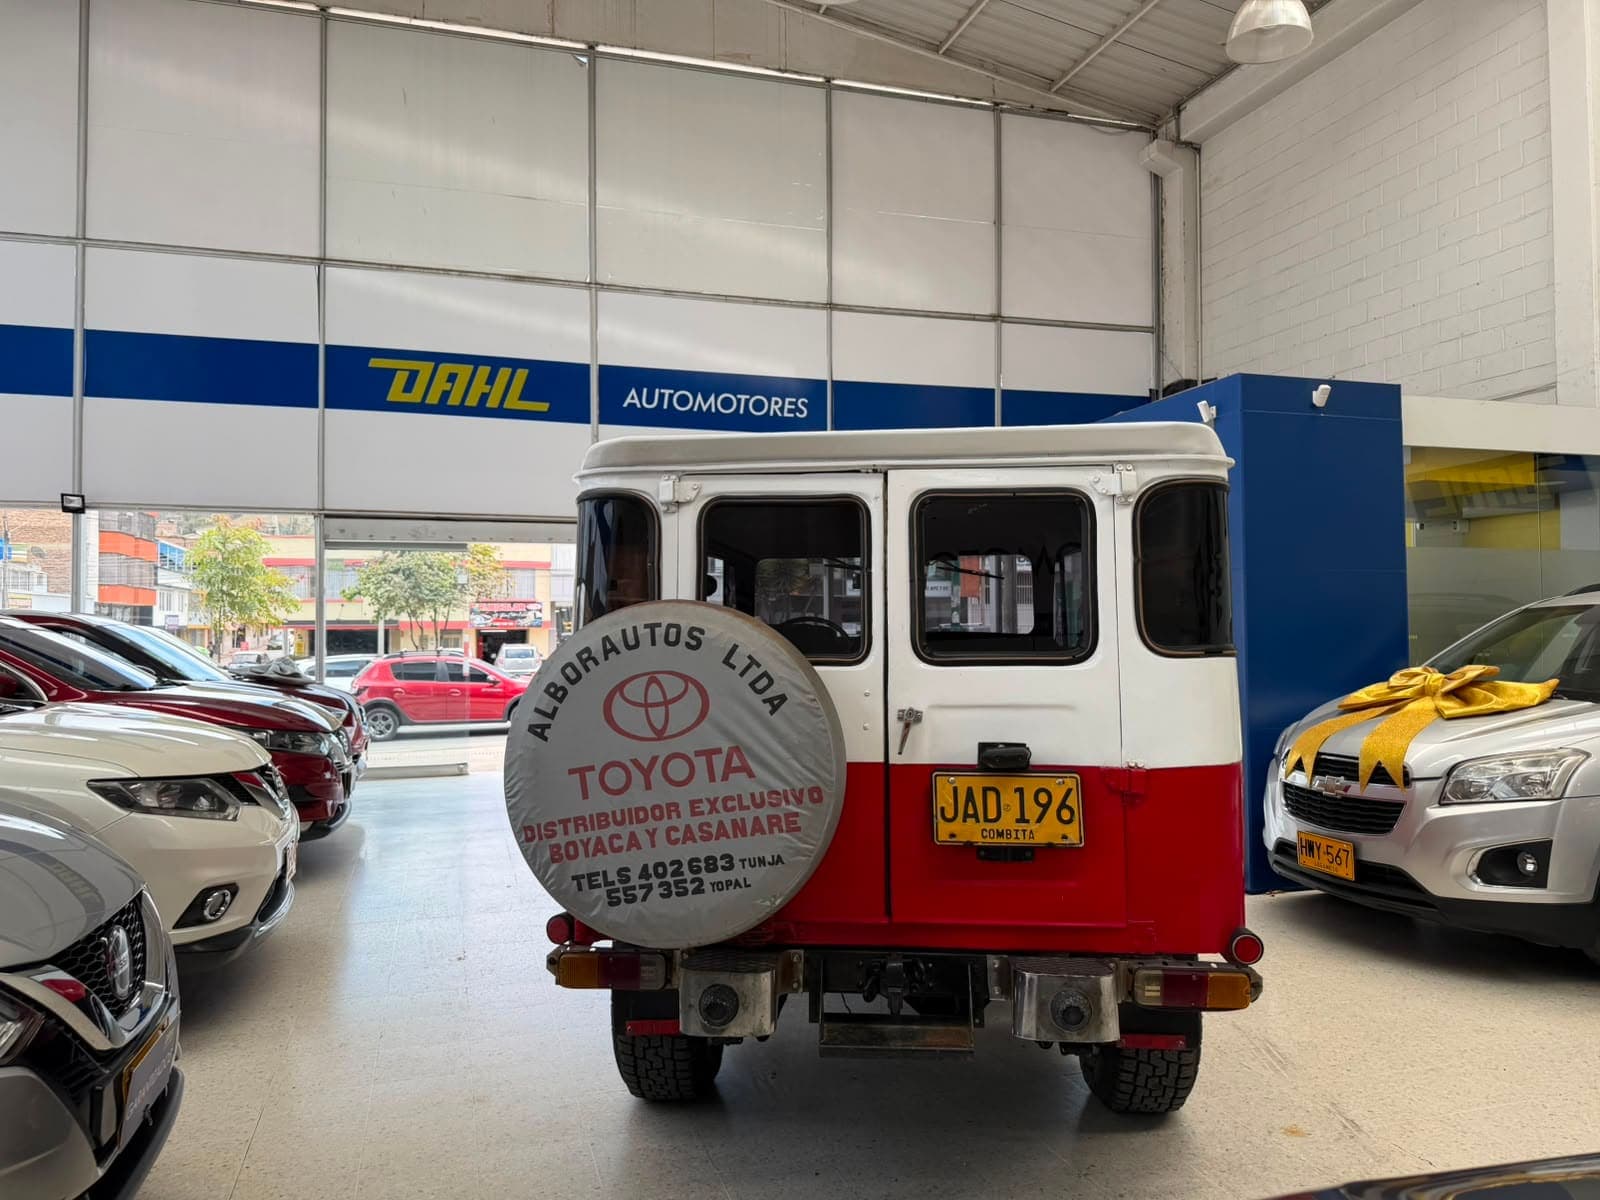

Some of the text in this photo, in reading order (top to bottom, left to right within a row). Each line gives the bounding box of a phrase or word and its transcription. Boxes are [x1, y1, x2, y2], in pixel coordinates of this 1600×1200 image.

[368, 357, 551, 412] DAHL
[622, 387, 809, 419] AUTOMOTORES
[527, 622, 788, 742] ALBORAUTOS LTDA
[568, 745, 757, 800] TOYOTA
[523, 785, 824, 844] DISTRIBUIDOR EXCLUSIVO
[940, 786, 1076, 825] JAD 196
[548, 812, 800, 864] BOYACA Y CASANARE
[980, 828, 1035, 841] COMBITA
[1300, 837, 1322, 860] HWY
[1326, 844, 1350, 869] 567
[571, 867, 631, 893] TELS
[739, 854, 784, 869] TUNJA
[709, 878, 752, 894] YOPAL
